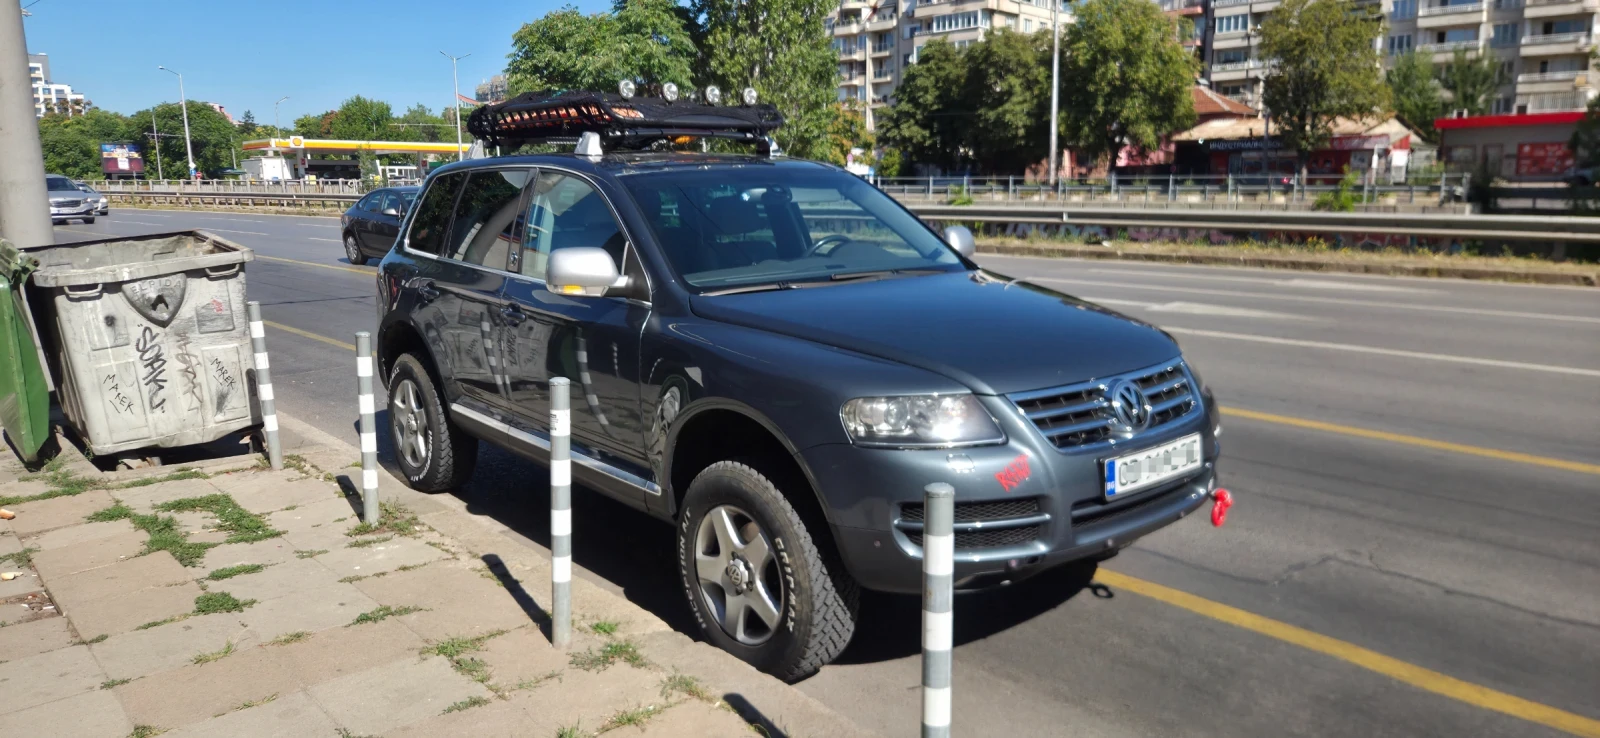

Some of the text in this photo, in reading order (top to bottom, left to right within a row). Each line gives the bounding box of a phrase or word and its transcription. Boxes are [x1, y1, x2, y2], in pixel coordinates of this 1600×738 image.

[131, 279, 182, 294] ELPIDA
[211, 357, 237, 390] MAREK
[103, 373, 134, 414] MAREK
[1106, 481, 1115, 490] BG
[679, 507, 708, 630] INCEPTION A/T
[774, 537, 796, 633] GRIPMAX
